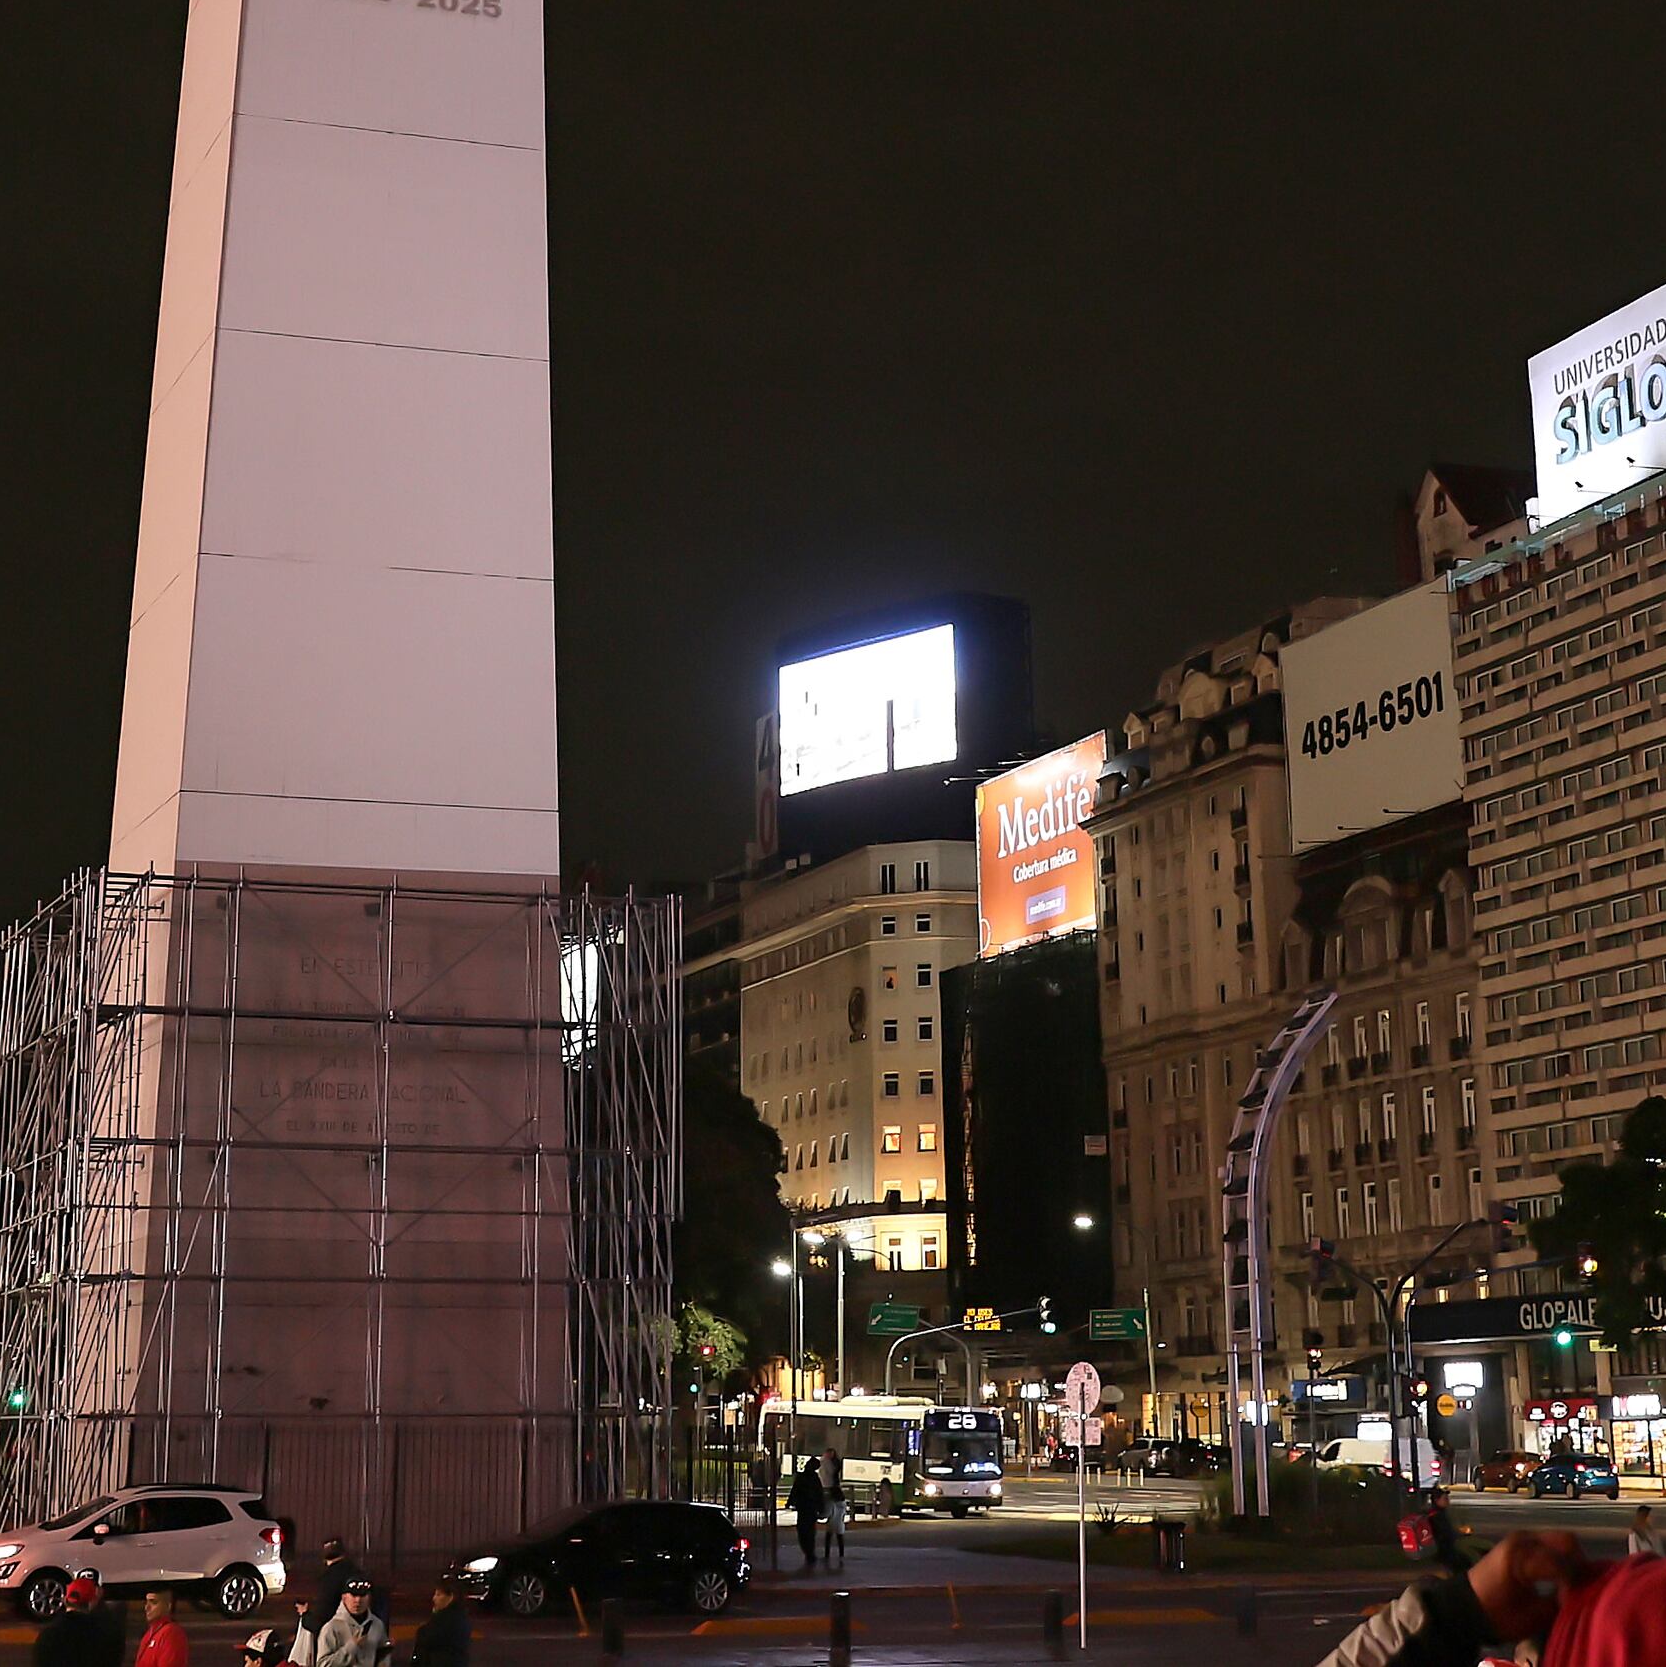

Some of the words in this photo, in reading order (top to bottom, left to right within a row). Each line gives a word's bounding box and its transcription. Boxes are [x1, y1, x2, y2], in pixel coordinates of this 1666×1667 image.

[1302, 670, 1444, 759] 4854-6501
[998, 770, 1092, 859] Medifé
[1013, 855, 1050, 884] Cobertura
[1050, 846, 1078, 871] médica
[948, 1414, 977, 1430] 28
